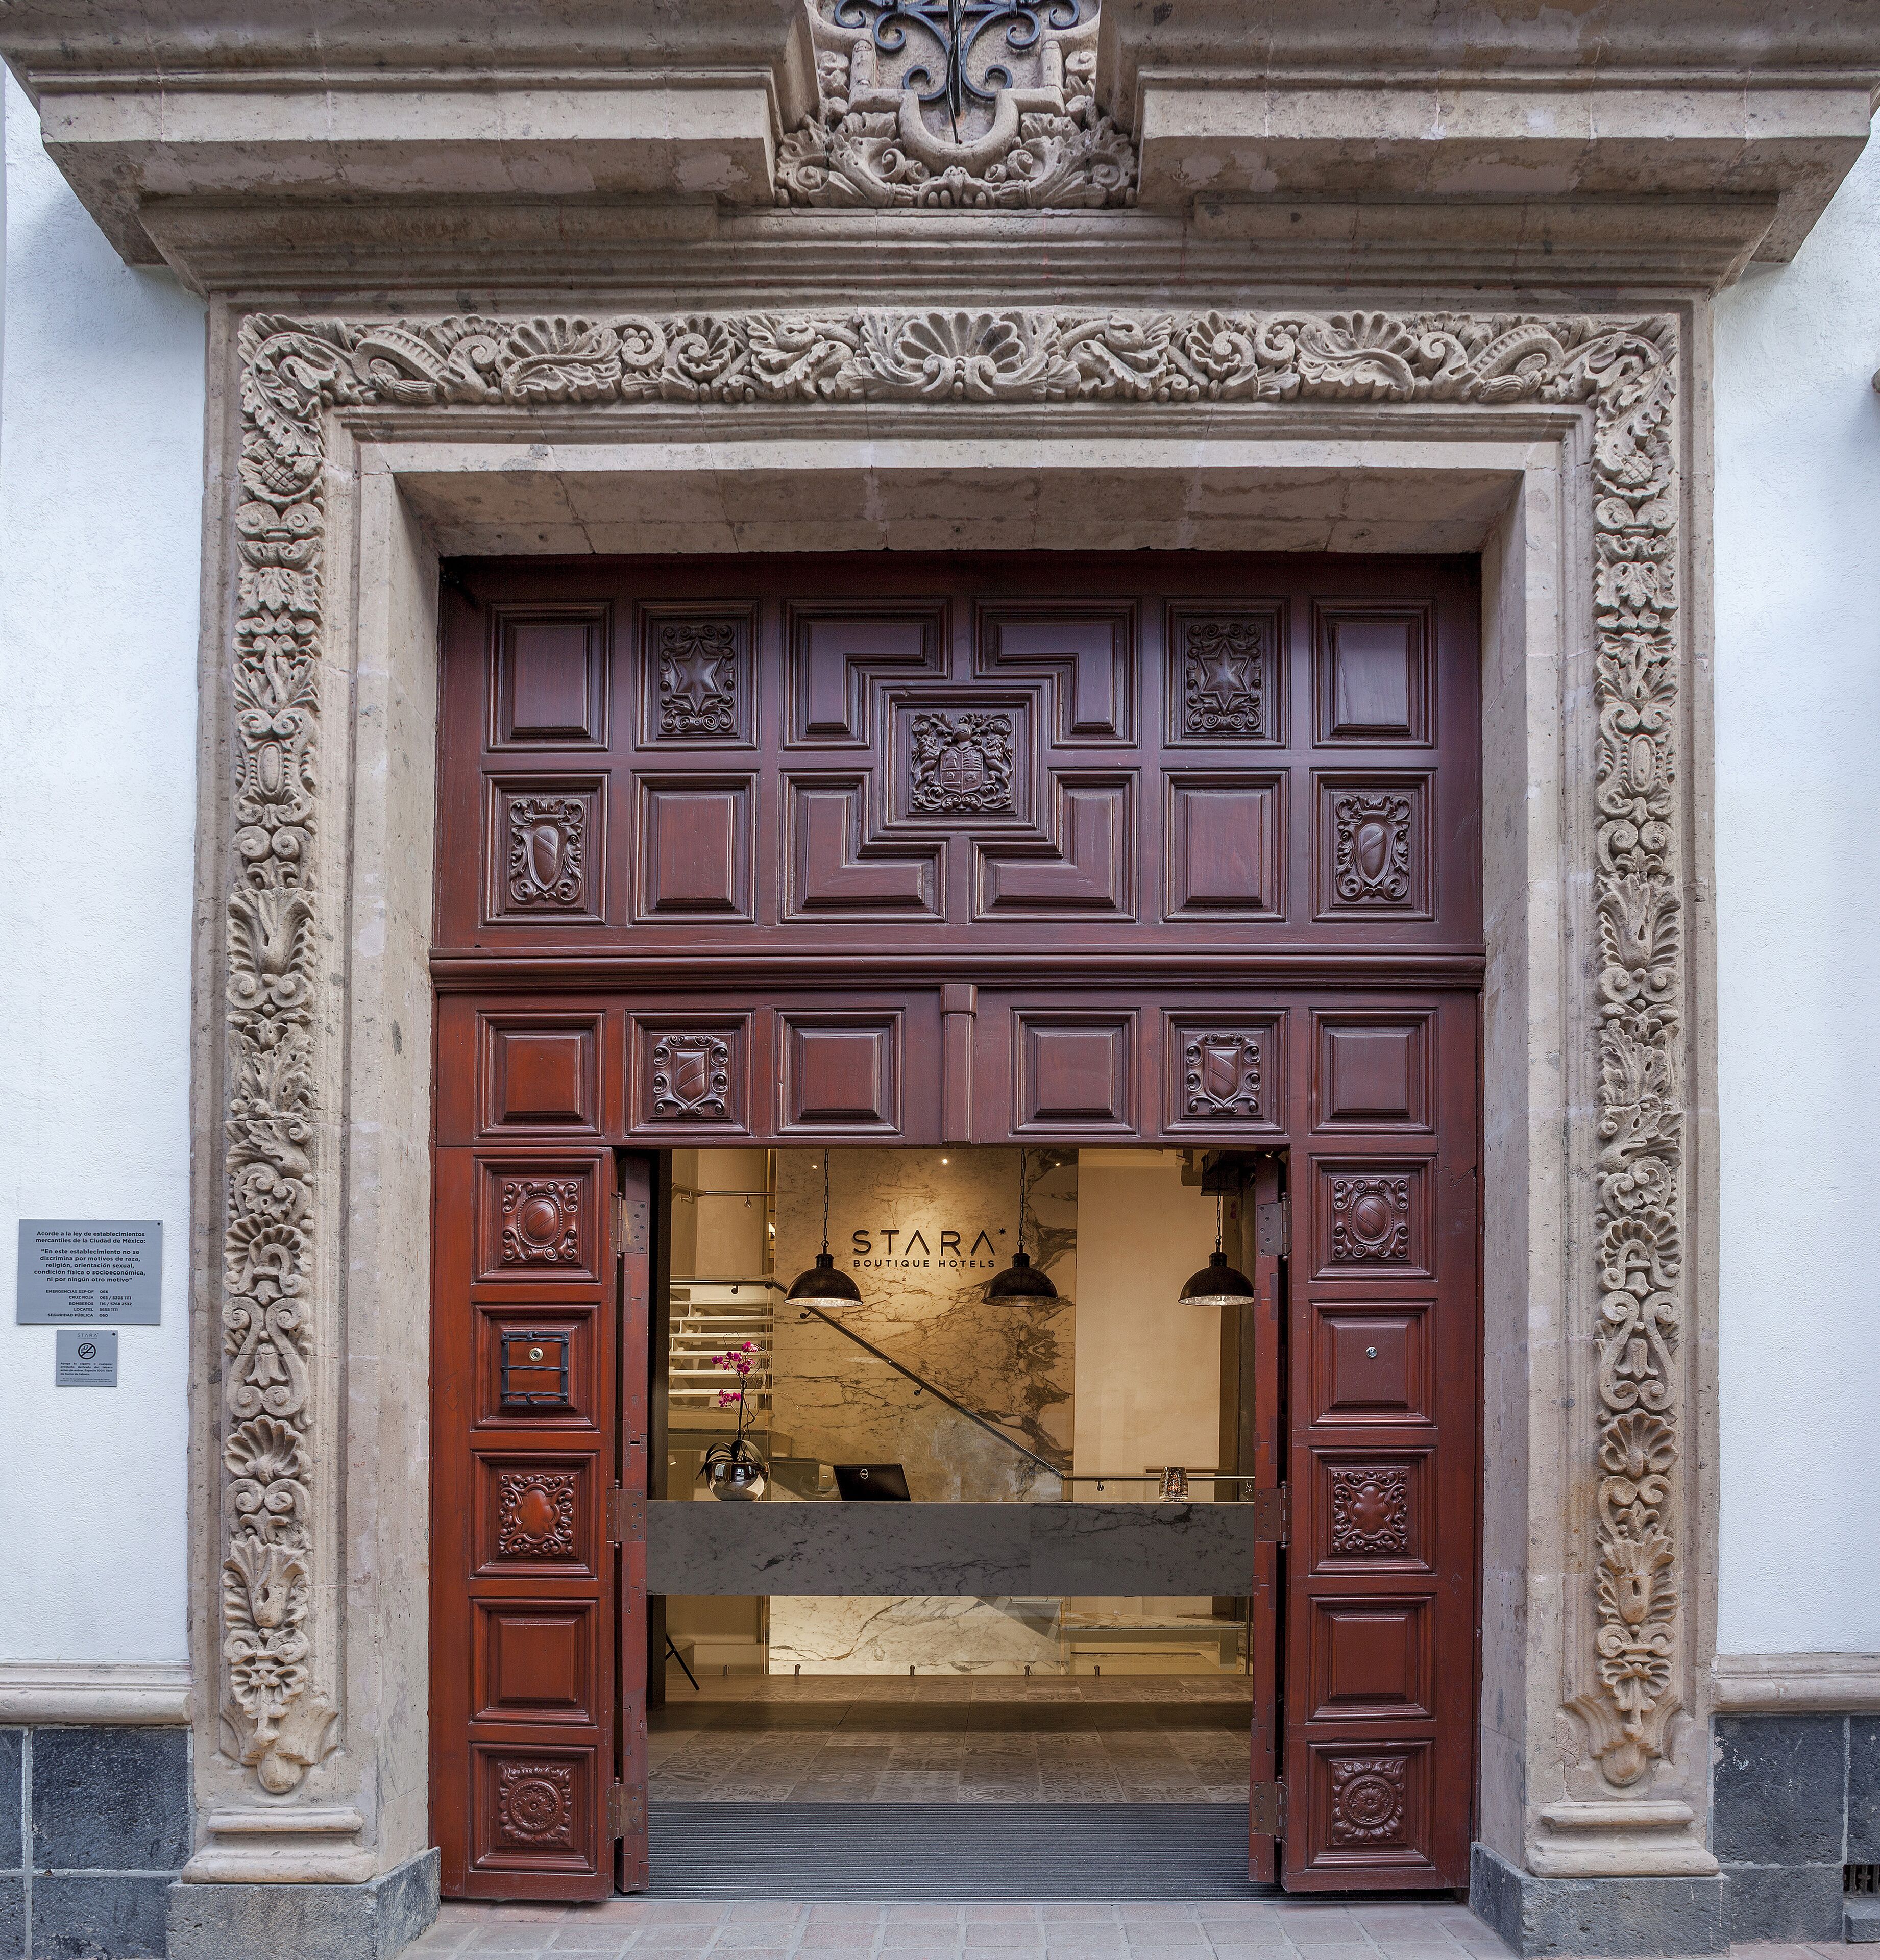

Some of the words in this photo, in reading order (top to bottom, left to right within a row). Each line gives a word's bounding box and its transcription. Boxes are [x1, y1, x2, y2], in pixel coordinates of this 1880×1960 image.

[852, 1229, 996, 1256] STARA
[853, 1259, 930, 1268] BOUTIQUE
[938, 1259, 995, 1268] HOTELS
